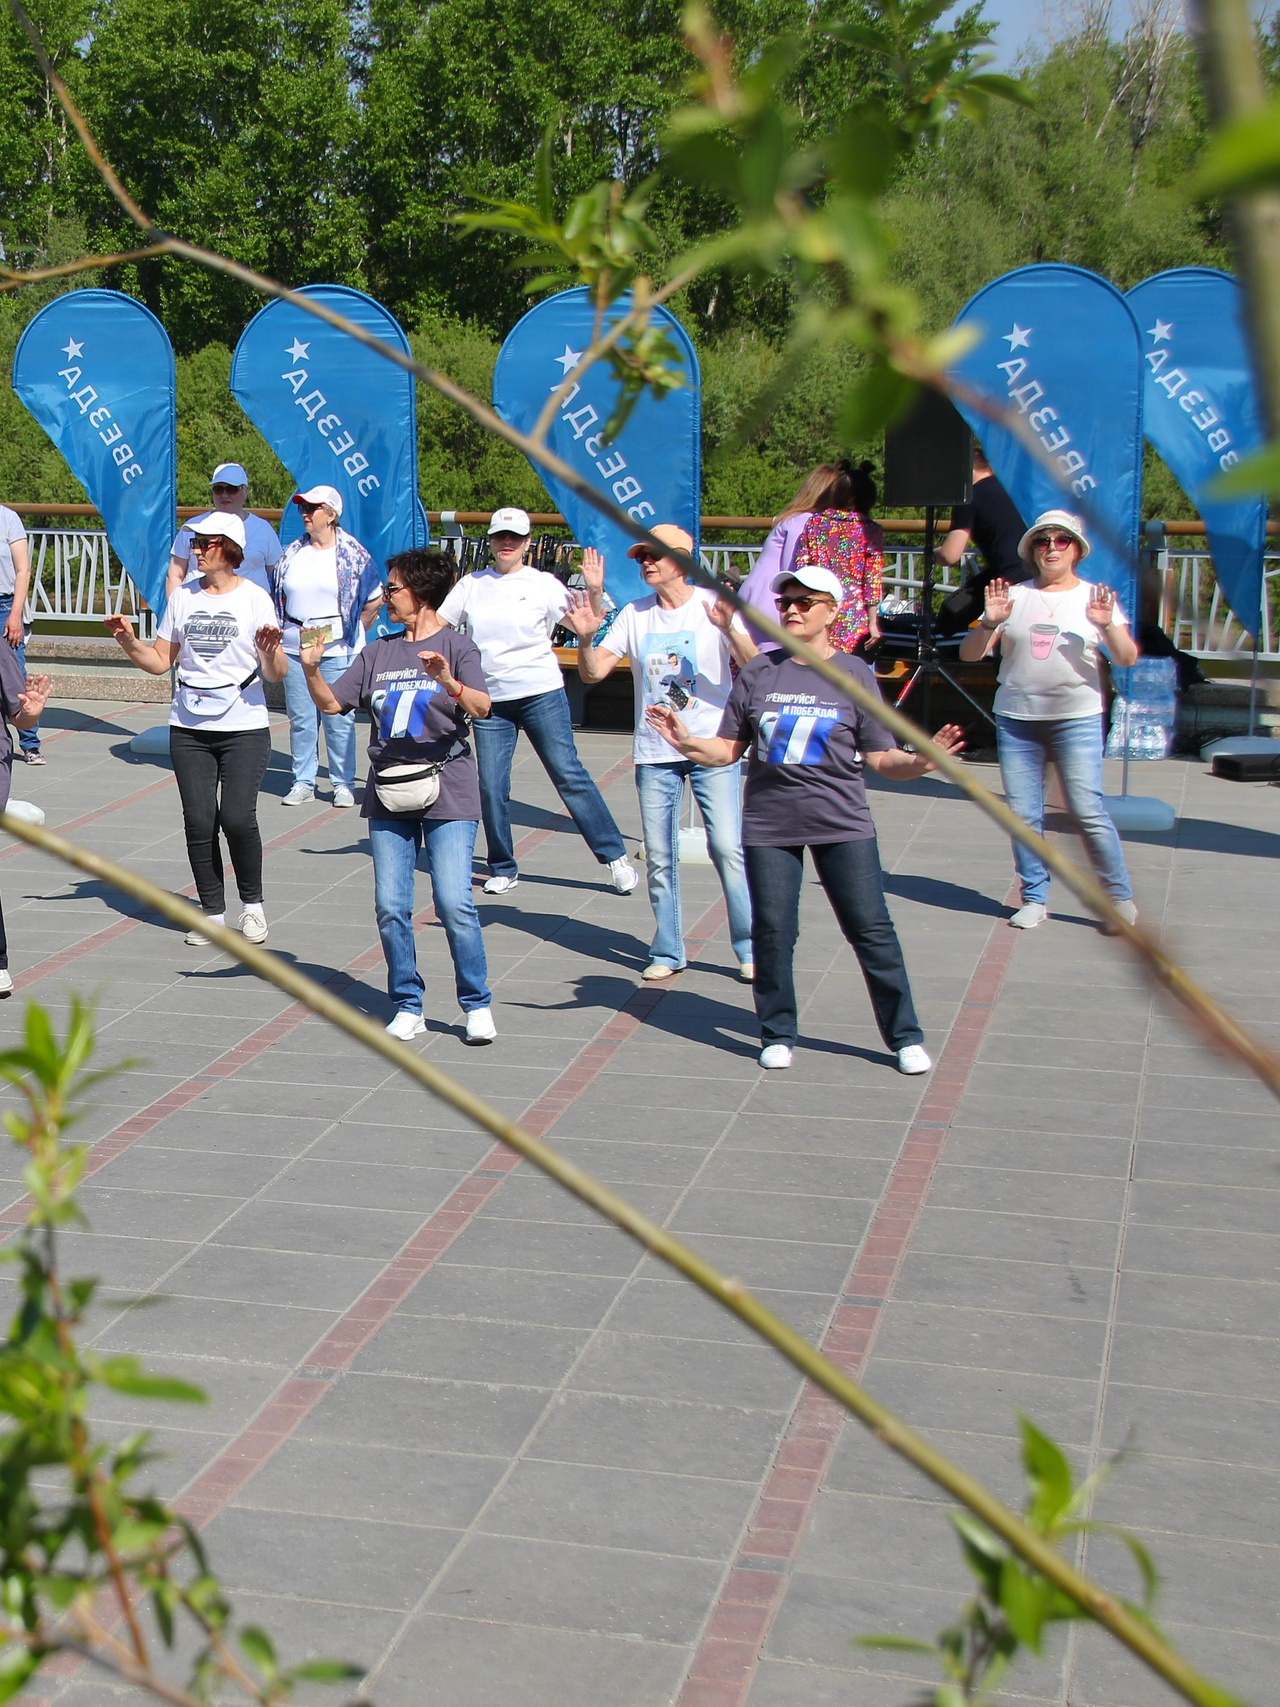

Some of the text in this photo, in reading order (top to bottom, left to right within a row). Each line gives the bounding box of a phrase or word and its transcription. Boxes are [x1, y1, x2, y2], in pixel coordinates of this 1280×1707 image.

[375, 668, 418, 682] ТРЕНИРУЙСЯ
[396, 680, 438, 692] ПОБЕЖДАЙ
[765, 692, 816, 705] ТРЕНИРУЙСЯ
[790, 705, 838, 720] ПОБЕЖДАЙ
